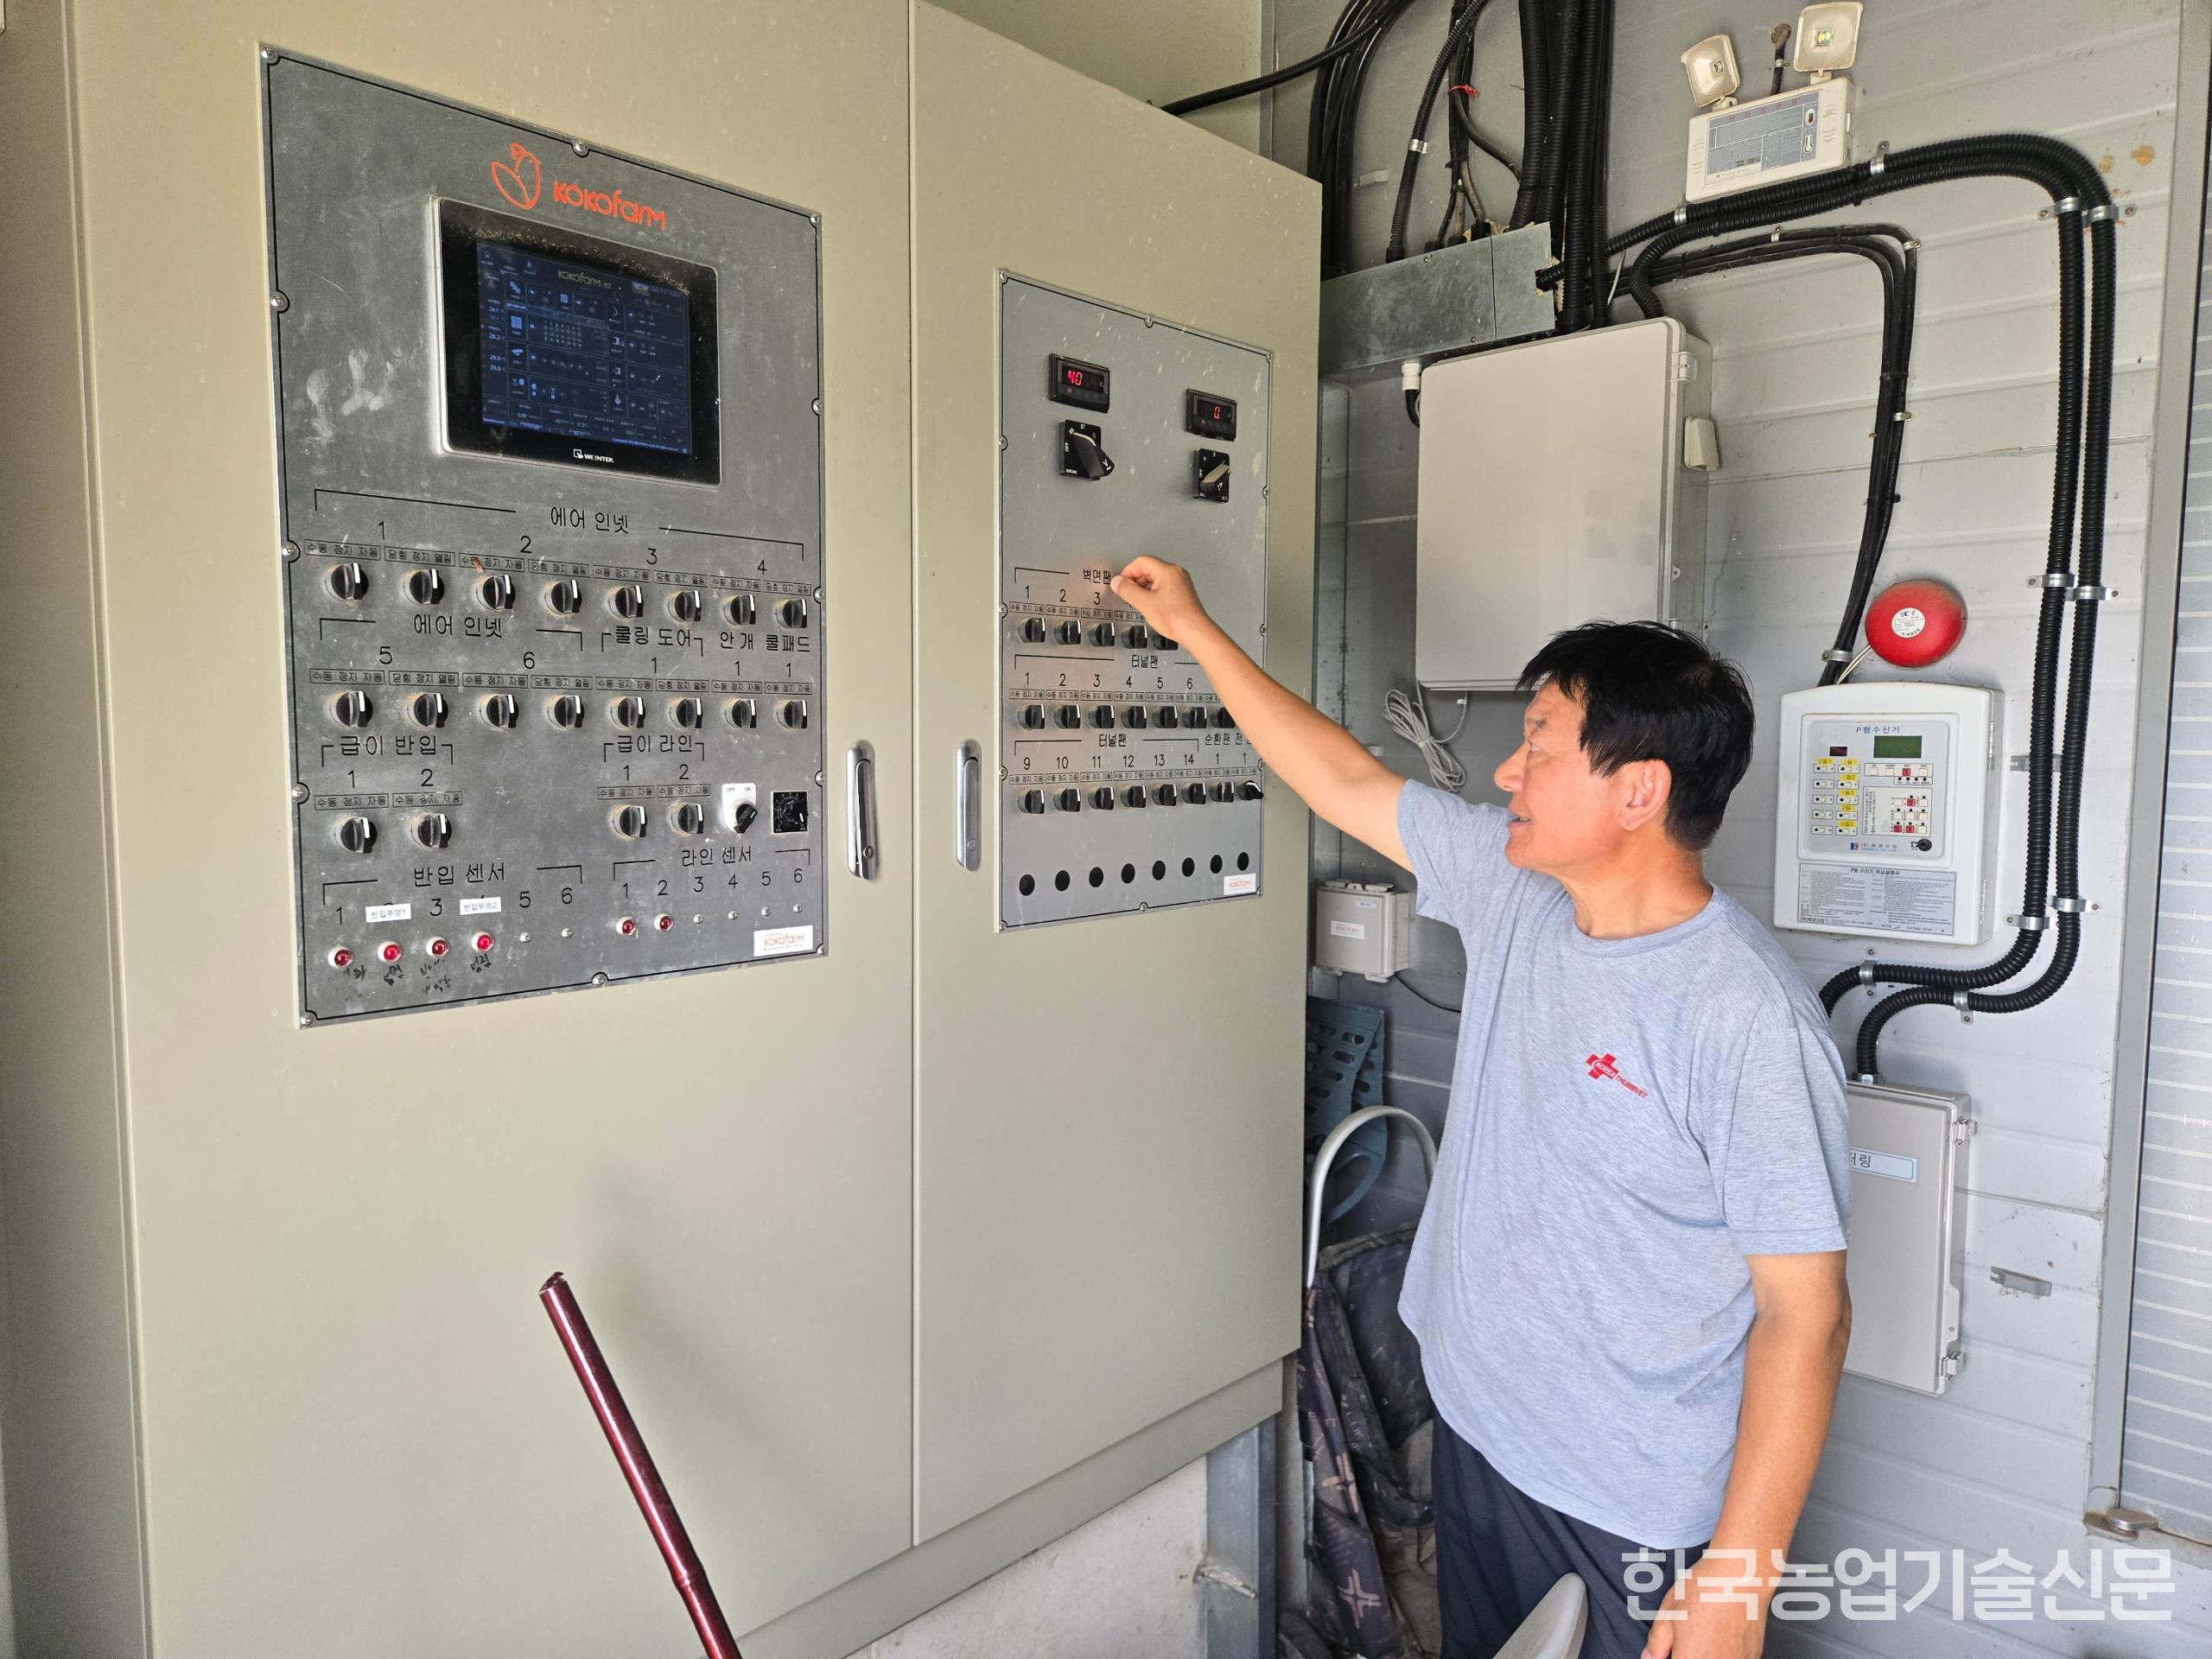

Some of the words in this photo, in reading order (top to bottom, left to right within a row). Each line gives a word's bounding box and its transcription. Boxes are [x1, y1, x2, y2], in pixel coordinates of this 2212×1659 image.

[1067, 370, 1083, 386] 40
[550, 505, 586, 530] 에어
[594, 512, 629, 534] 인넷
[378, 521, 386, 540] 1
[519, 535, 532, 554] 2
[645, 548, 658, 565] 3
[756, 559, 767, 575] 4
[1025, 585, 1030, 599] 1
[1059, 588, 1067, 602] 2
[1093, 592, 1101, 605] 3
[413, 613, 454, 636] 에어
[463, 616, 504, 639] 인넷
[615, 626, 650, 645] 쿨링
[658, 627, 691, 648] 도어
[765, 633, 811, 653] 쿨패드
[378, 645, 393, 664] 5
[523, 651, 536, 670] 6
[651, 657, 658, 674] 1
[1131, 654, 1158, 670] 터널팬
[312, 671, 333, 682] 수동
[339, 672, 358, 683] 정지
[363, 673, 383, 683] 자동
[734, 660, 741, 677] 1
[785, 663, 792, 678] 1
[1025, 671, 1030, 685] 1
[1059, 673, 1067, 687] 2
[1093, 674, 1101, 688] 3
[1125, 675, 1133, 689] 4
[1157, 677, 1164, 689] 5
[1186, 677, 1193, 690] 6
[339, 734, 384, 756] 급이
[394, 734, 437, 756] 반입
[617, 734, 652, 753] 급이
[659, 734, 692, 753] 라인
[1098, 734, 1127, 747] 터널팬
[1205, 733, 1230, 746] 순환팬
[1023, 756, 1031, 771] 9
[1056, 756, 1069, 769] 10
[1091, 755, 1102, 768] 11
[1122, 754, 1135, 767] 12
[1154, 753, 1166, 766] 13
[1183, 753, 1194, 766] 14
[1216, 753, 1220, 765] 1
[1243, 753, 1247, 764] 1
[347, 770, 356, 789] 1
[421, 768, 435, 787] 2
[623, 765, 630, 781] 1
[679, 764, 690, 780] 2
[317, 797, 337, 808] 수동
[343, 796, 362, 807] 정지
[367, 795, 386, 805] 자동
[682, 848, 714, 867] 라인
[721, 845, 751, 864] 센서
[414, 864, 454, 887] 반입
[466, 861, 505, 883] 센서
[623, 882, 629, 899] 1
[658, 880, 669, 896] 2
[693, 876, 704, 893] 3
[728, 873, 738, 889] 4
[761, 871, 772, 887] 5
[793, 868, 803, 883] 6
[429, 898, 443, 916] 3
[519, 890, 531, 908] 5
[561, 887, 573, 905] 6
[334, 906, 344, 925] 1
